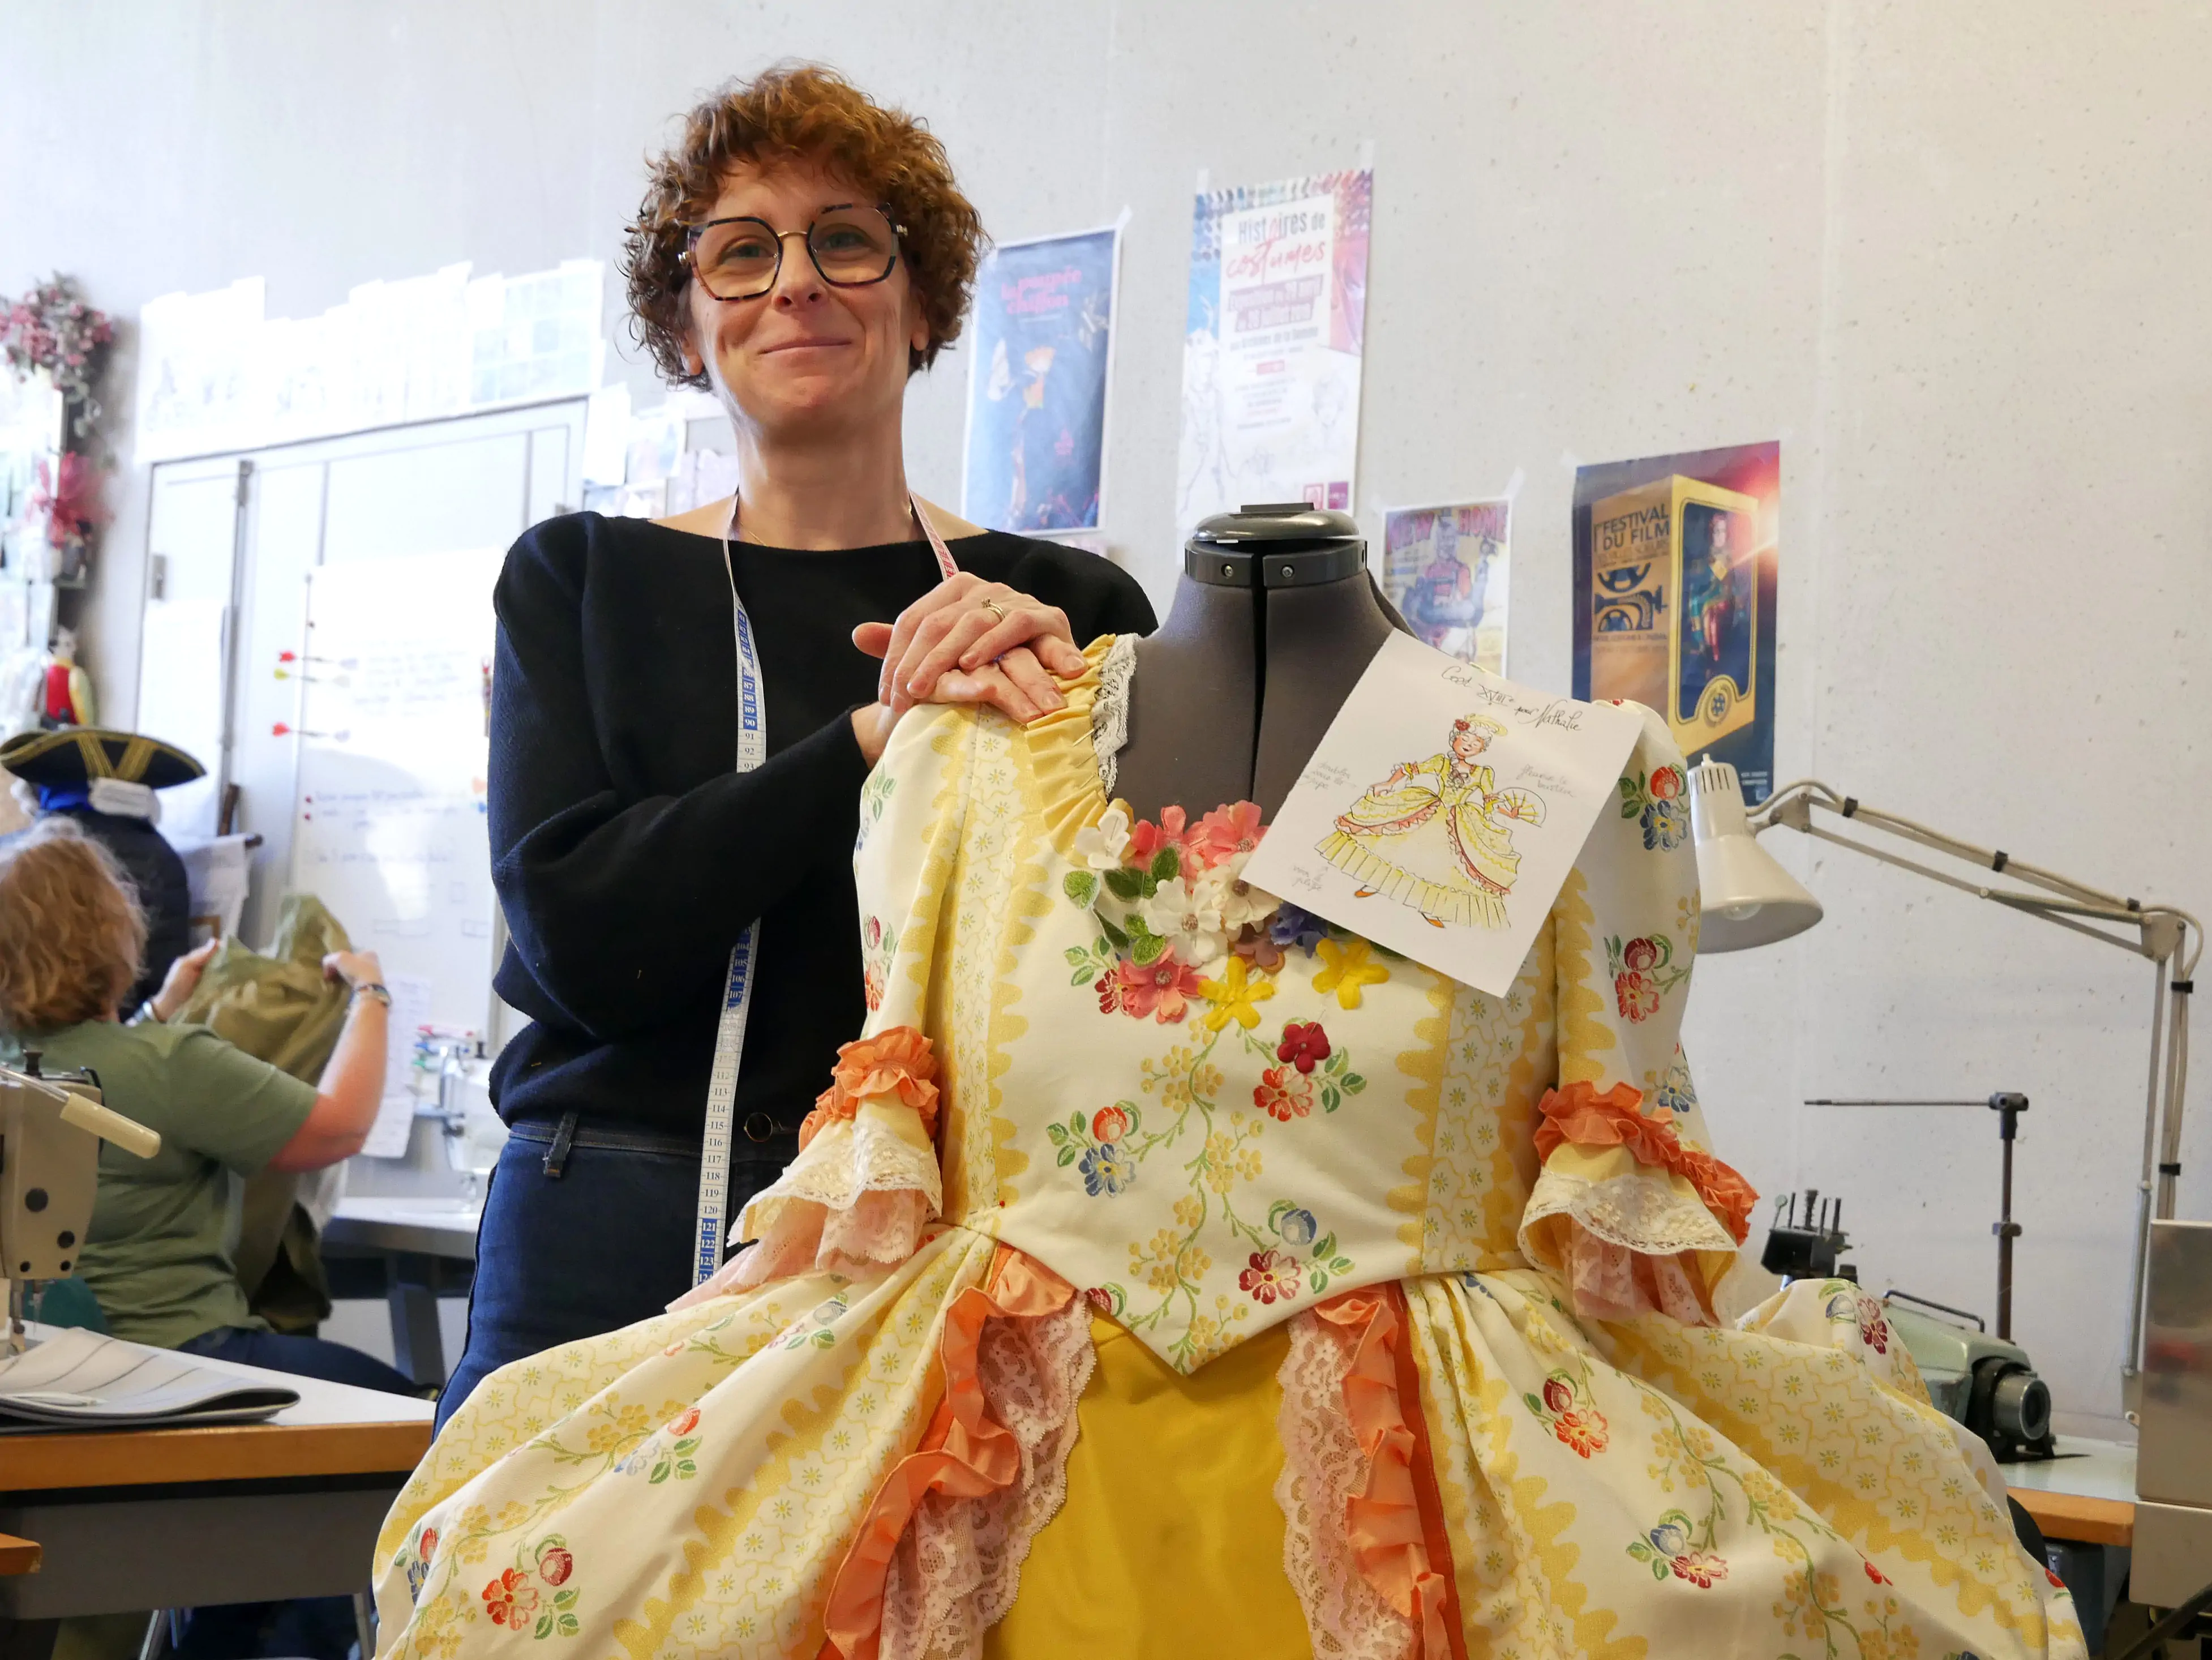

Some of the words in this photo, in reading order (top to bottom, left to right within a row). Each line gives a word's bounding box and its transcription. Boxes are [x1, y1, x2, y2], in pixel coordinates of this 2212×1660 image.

[1311, 212, 1325, 230] de
[1604, 503, 1669, 534] FESTIVAL
[1604, 533, 1624, 550] DU
[1631, 520, 1669, 544] FILM
[1517, 699, 1583, 731] Nathalie
[745, 718, 755, 727] 90
[732, 974, 745, 983] 106
[715, 1088, 727, 1096] 113
[711, 1121, 724, 1130] 115
[709, 1138, 722, 1146] 116
[708, 1155, 721, 1163] 117
[706, 1171, 720, 1180] 118
[705, 1189, 719, 1197] 119
[704, 1205, 718, 1214] 120
[703, 1222, 715, 1231] 121
[702, 1239, 714, 1248] 122
[700, 1256, 714, 1266] 123
